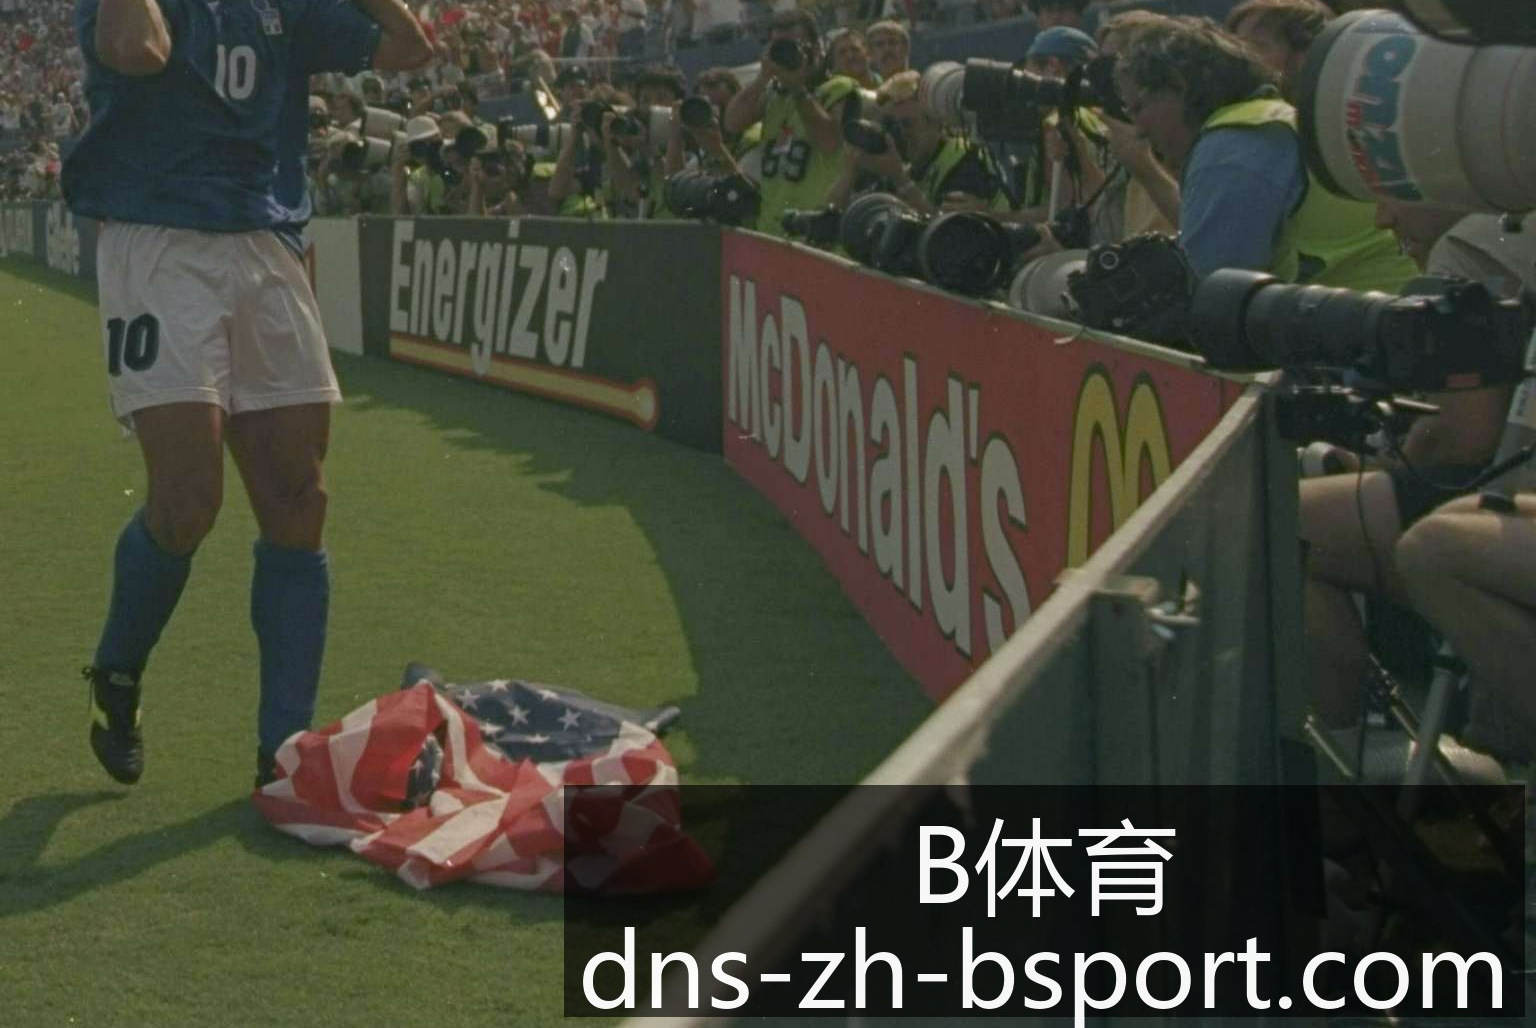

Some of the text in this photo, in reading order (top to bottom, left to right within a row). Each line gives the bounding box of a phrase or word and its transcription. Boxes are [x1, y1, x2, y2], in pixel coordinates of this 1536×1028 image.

[215, 43, 257, 101] 10
[106, 313, 161, 377] 10
[389, 220, 609, 375] Energizer
[728, 273, 1032, 662] McDonald's
